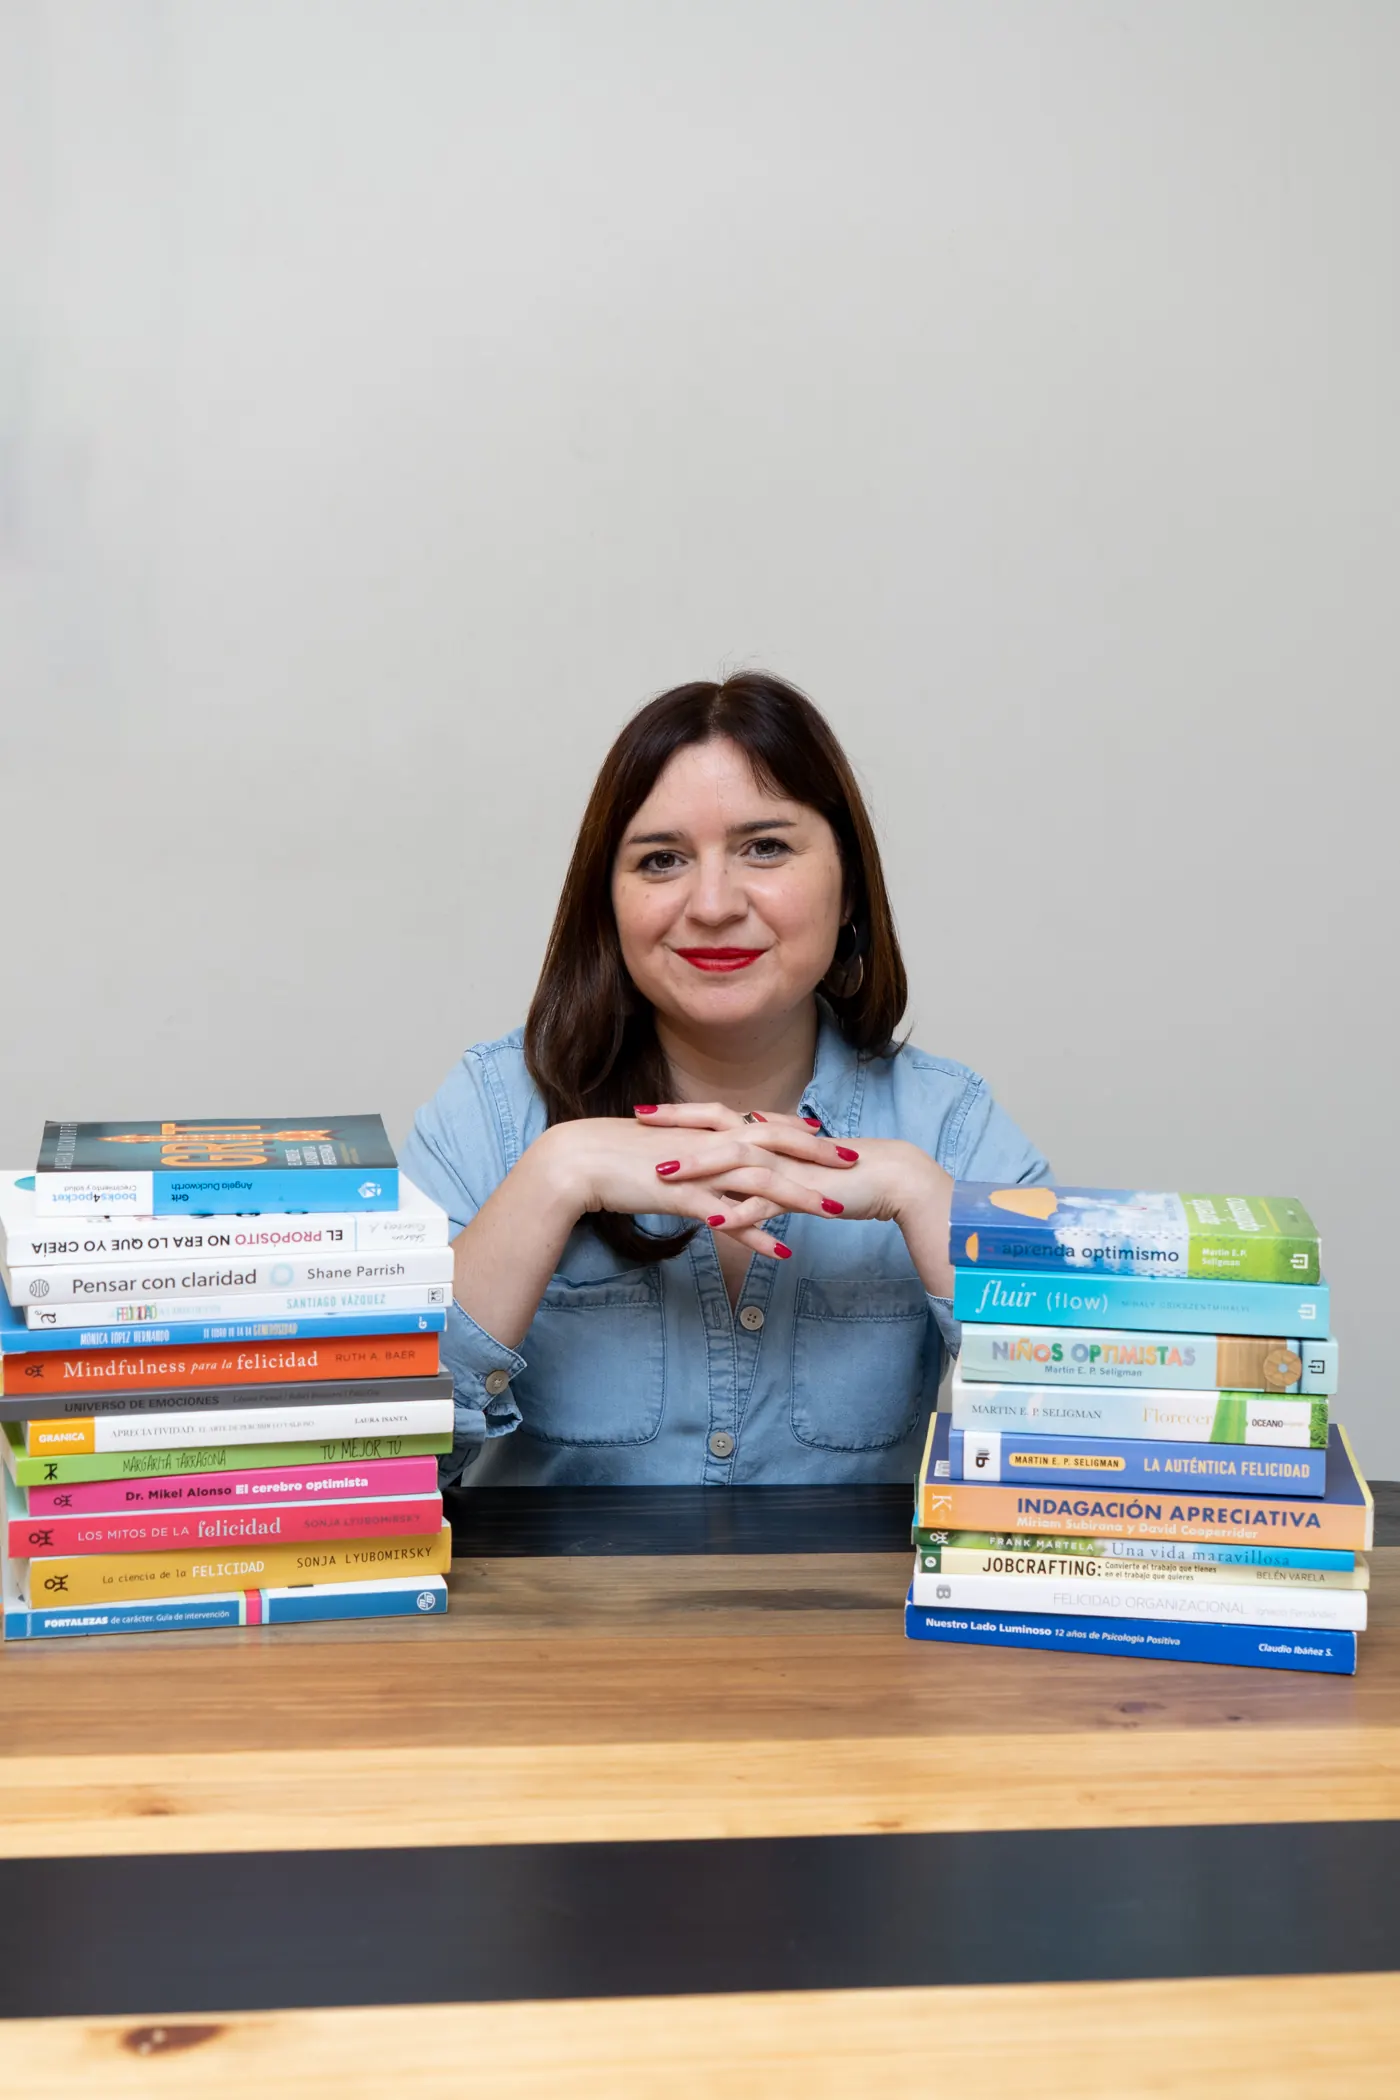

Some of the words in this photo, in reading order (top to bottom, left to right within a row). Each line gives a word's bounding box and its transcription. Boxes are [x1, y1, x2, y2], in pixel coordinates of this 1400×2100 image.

[171, 1182, 220, 1191] Duckworth
[222, 1181, 253, 1191] Angela
[52, 1192, 137, 1202] books4pocket
[171, 1194, 189, 1202] Grit
[173, 1236, 203, 1247] ERA
[207, 1235, 230, 1246] NO
[235, 1231, 322, 1247] PROPÓSITO
[326, 1229, 343, 1241] EL
[31, 1242, 79, 1257] CREÍA
[84, 1240, 106, 1251] YO
[112, 1238, 143, 1250] QUE
[148, 1237, 168, 1249] LO
[1002, 1243, 1076, 1258] aprenda
[1082, 1246, 1180, 1263] optimismo
[1202, 1248, 1230, 1257] Martin
[1202, 1257, 1240, 1267] Seligman
[307, 1267, 352, 1280] Shane
[356, 1264, 405, 1277] Parrish
[73, 1278, 137, 1294] Pensar
[142, 1277, 175, 1291] con
[181, 1269, 257, 1288] claridad
[286, 1296, 336, 1309] SANTIAGO
[341, 1294, 386, 1306] VÁZQUEZ
[975, 1279, 1037, 1313] fluir
[1046, 1291, 1109, 1313] (flow)
[335, 1352, 366, 1363] RUTH
[385, 1351, 415, 1361] BAER
[992, 1338, 1063, 1363] NIÑOS
[1071, 1343, 1196, 1367] OPTIMISTAS
[63, 1358, 186, 1379] Mindfulness
[191, 1362, 217, 1375] para
[221, 1359, 232, 1370] la
[236, 1351, 318, 1370] felicidad
[1044, 1365, 1075, 1375] Martin
[1077, 1366, 1086, 1375] E.
[1100, 1367, 1142, 1378] Seligman
[65, 1401, 126, 1413] UNIVERSO
[129, 1399, 145, 1410] DE
[149, 1396, 219, 1408] EMOCIONES
[971, 1404, 1017, 1416] MARTIN
[1020, 1407, 1028, 1416] E.
[1032, 1407, 1039, 1417] P.
[1043, 1408, 1101, 1419] SELIGMAN
[354, 1417, 380, 1425] LAURA
[382, 1415, 408, 1423] ISANTA
[1143, 1407, 1213, 1425] Florecer
[1251, 1418, 1283, 1428] OCEANO
[38, 1431, 85, 1443] GRANICA
[320, 1444, 335, 1460] TU
[341, 1438, 382, 1460] MEJOR
[387, 1436, 402, 1456] TÚ
[122, 1454, 172, 1473] MARGARITA
[176, 1450, 227, 1469] TARRAGONA
[1015, 1455, 1048, 1465] MARTIN
[1052, 1457, 1060, 1466] E.
[1063, 1458, 1071, 1466] P.
[1074, 1458, 1119, 1468] SELIGMAN
[1144, 1458, 1160, 1472] LA
[1164, 1457, 1236, 1475] AUTÉNTICA
[1241, 1461, 1311, 1478] FELICIDAD
[126, 1491, 144, 1501] Dr.
[148, 1488, 182, 1499] Mikel
[187, 1486, 232, 1497] Alonso
[236, 1484, 248, 1495] El
[252, 1481, 302, 1493] cerebro
[306, 1477, 369, 1490] optimista
[1017, 1497, 1162, 1520] INDAGACIÓN
[1170, 1506, 1321, 1528] APRECIATIVA
[77, 1531, 103, 1541] LOS
[107, 1528, 146, 1540] MITOS
[151, 1527, 168, 1537] DE
[173, 1526, 190, 1536] LA
[197, 1517, 282, 1538] felicidad
[304, 1518, 340, 1529] SONJA
[344, 1514, 421, 1526] LYUBOMIRSKY
[1016, 1517, 1061, 1528] Miriam
[1065, 1518, 1123, 1532] Subirana
[1127, 1524, 1136, 1535] y
[1139, 1522, 1177, 1534] David
[1181, 1524, 1259, 1539] Cooperrider
[989, 1537, 1030, 1547] FRANK
[1036, 1539, 1095, 1551] MARTELA
[297, 1555, 336, 1569] SONJA
[345, 1547, 433, 1565] LYUBOMIRSKY
[1111, 1542, 1144, 1557] Una
[1150, 1545, 1186, 1560] vida
[1192, 1549, 1290, 1567] maravillosa
[103, 1576, 113, 1584] La
[118, 1572, 155, 1582] ciencia
[159, 1570, 171, 1579] de
[176, 1569, 186, 1578] la
[192, 1560, 265, 1578] FELICIDAD
[982, 1557, 1102, 1577] JOBCRAFTING:
[1105, 1561, 1140, 1570] Convierte
[1151, 1564, 1177, 1573] trabajo
[1124, 1571, 1150, 1580] trabajo
[1167, 1573, 1194, 1581] quieres
[1256, 1570, 1287, 1582] BELÉN
[1289, 1572, 1325, 1582] VARELA
[1053, 1591, 1121, 1608] FELICIDAD
[1125, 1596, 1248, 1615] ORGANIZACIONAL
[44, 1616, 109, 1628] FORTALEZAS
[110, 1616, 121, 1625] de
[122, 1614, 154, 1624] carácter.
[156, 1613, 173, 1622] Guía
[174, 1612, 184, 1621] de
[184, 1610, 230, 1620] intervención
[925, 1617, 968, 1630] Nuestro
[971, 1620, 997, 1632] Lado
[999, 1623, 1052, 1636] Luminoso
[1055, 1628, 1064, 1637] 12
[1066, 1628, 1087, 1639] años
[1088, 1630, 1100, 1640] de
[1102, 1631, 1145, 1644] Psicología
[1146, 1635, 1181, 1646] Positiva
[1258, 1643, 1292, 1654] Claudio
[1294, 1645, 1324, 1657] Ibáñez
[1325, 1647, 1334, 1657] S.
